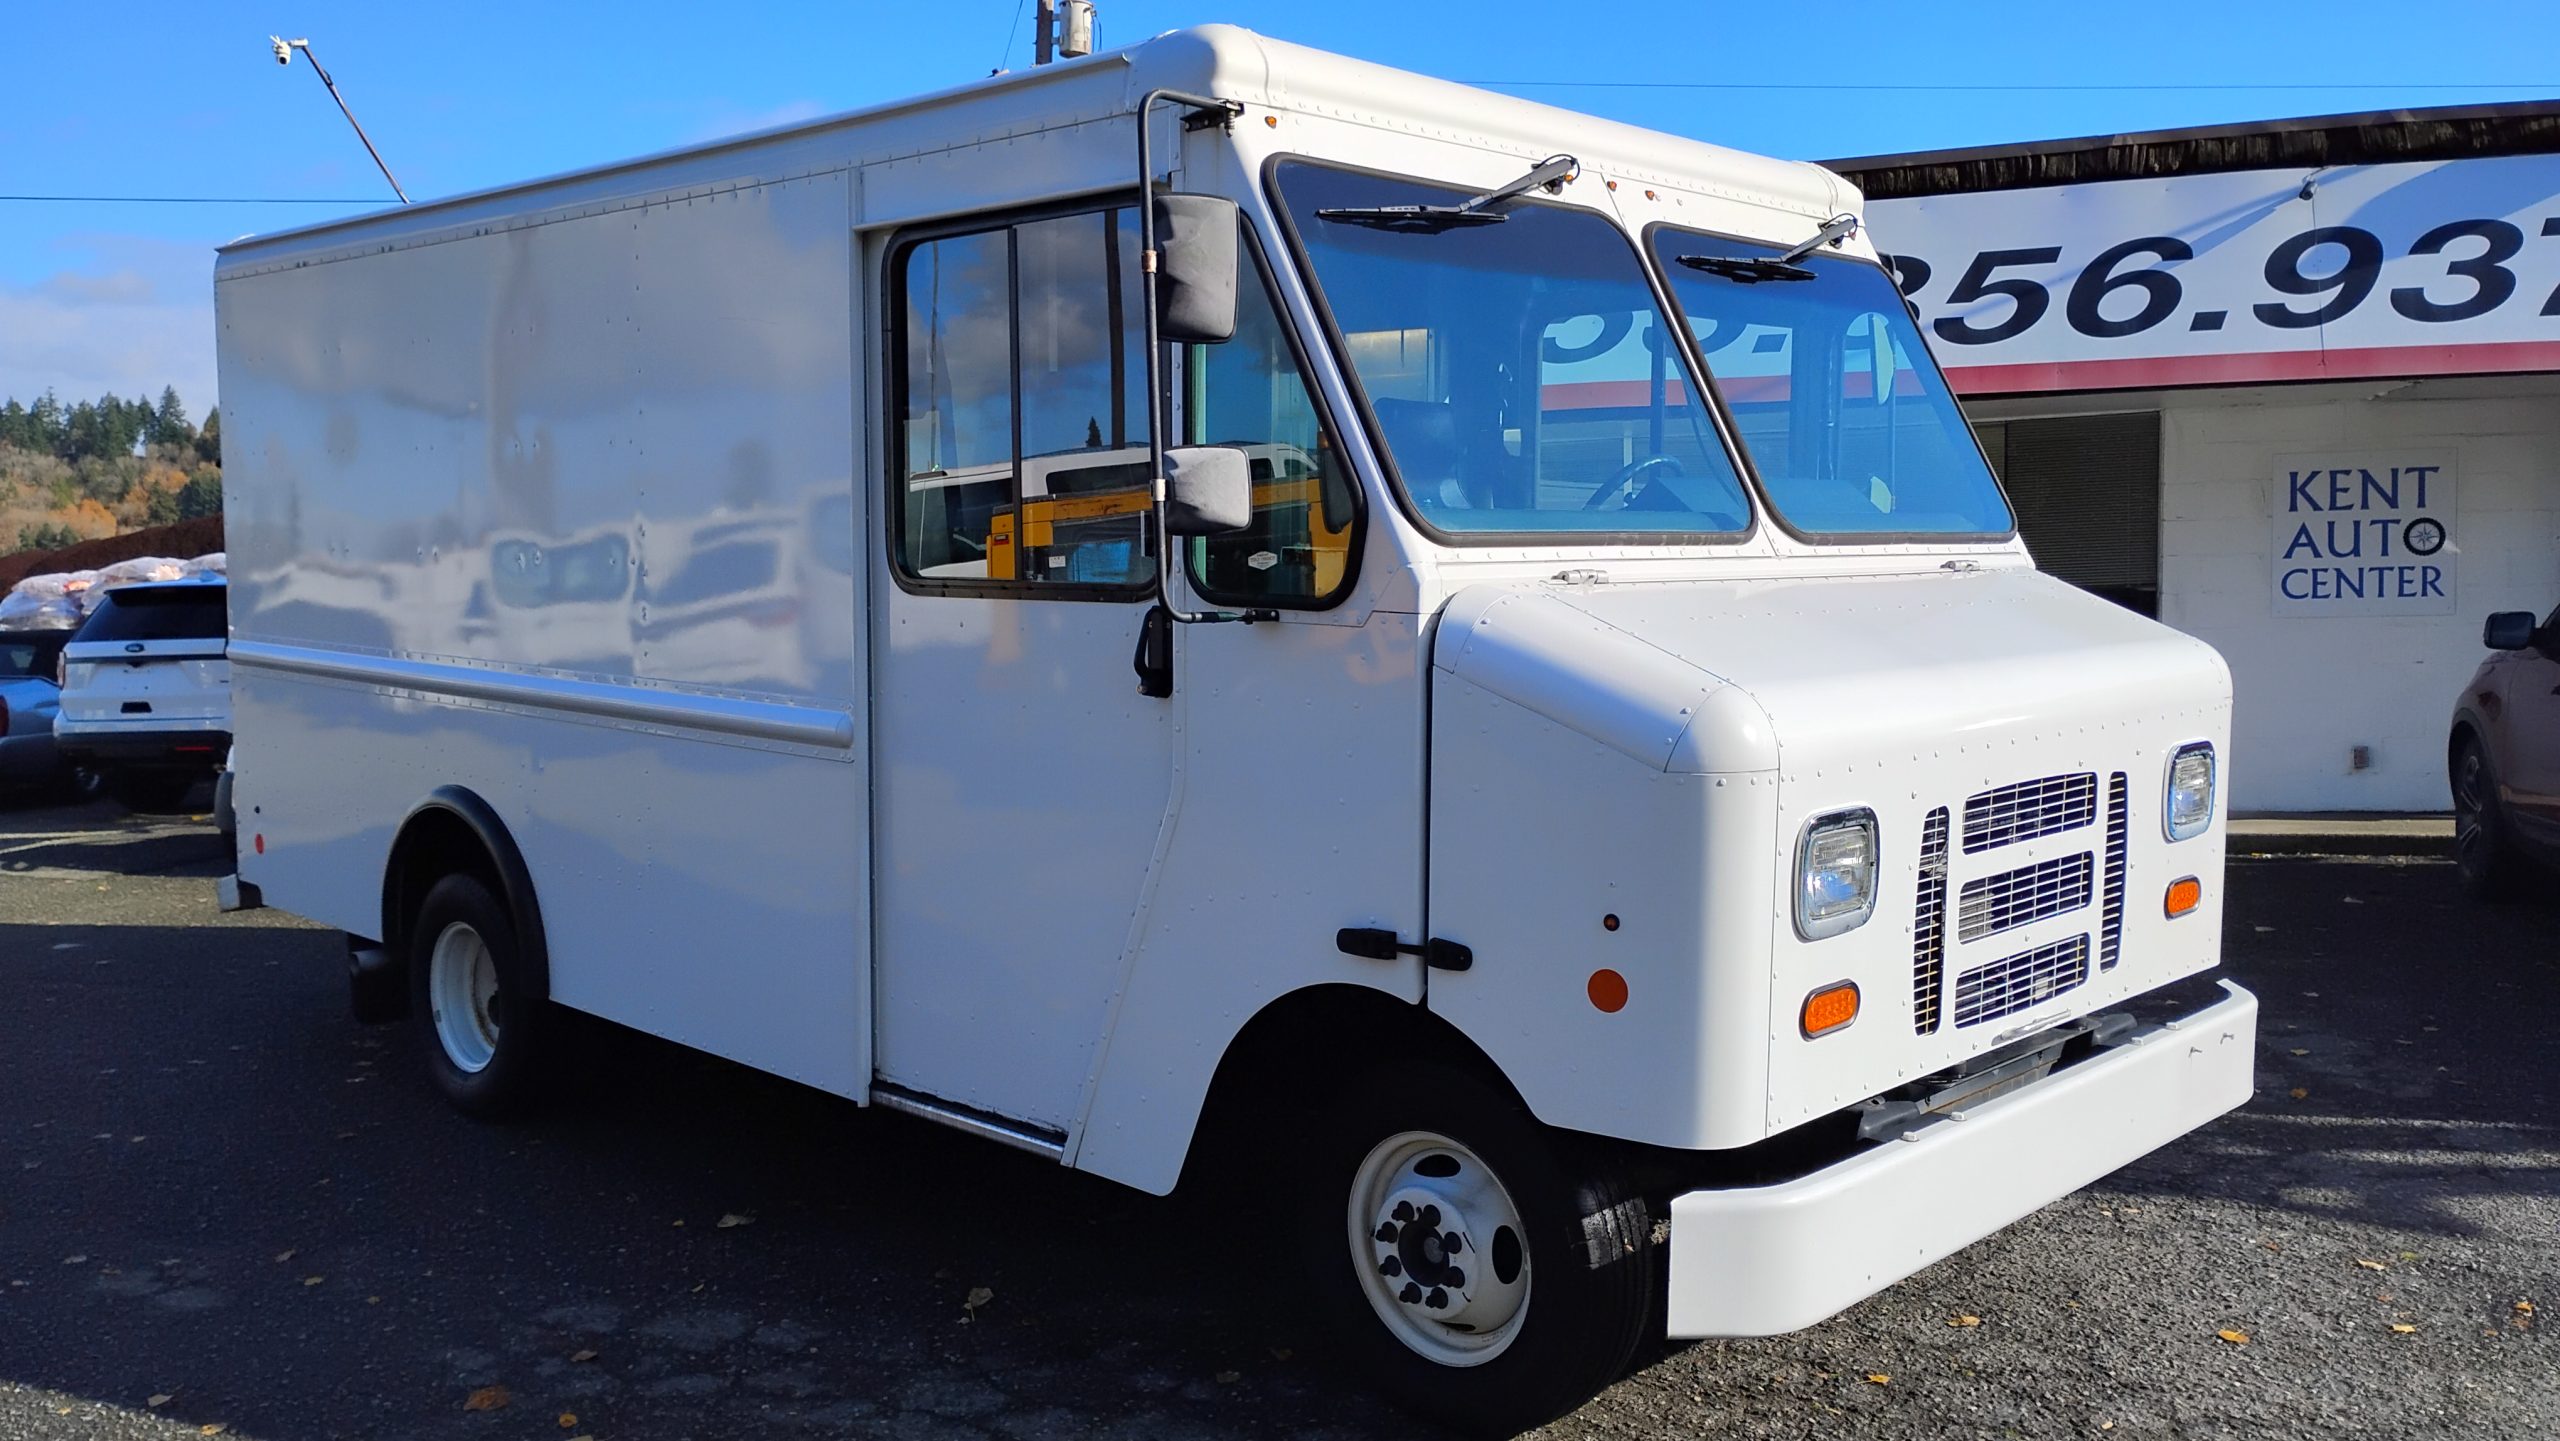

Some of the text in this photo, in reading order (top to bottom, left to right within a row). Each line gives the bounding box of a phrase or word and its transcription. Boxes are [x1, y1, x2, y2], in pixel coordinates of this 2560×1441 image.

[1893, 217, 2560, 345] 56.93
[2288, 466, 2440, 512] KENT
[2282, 517, 2446, 559] AUTO
[2281, 566, 2445, 600] CENTER
